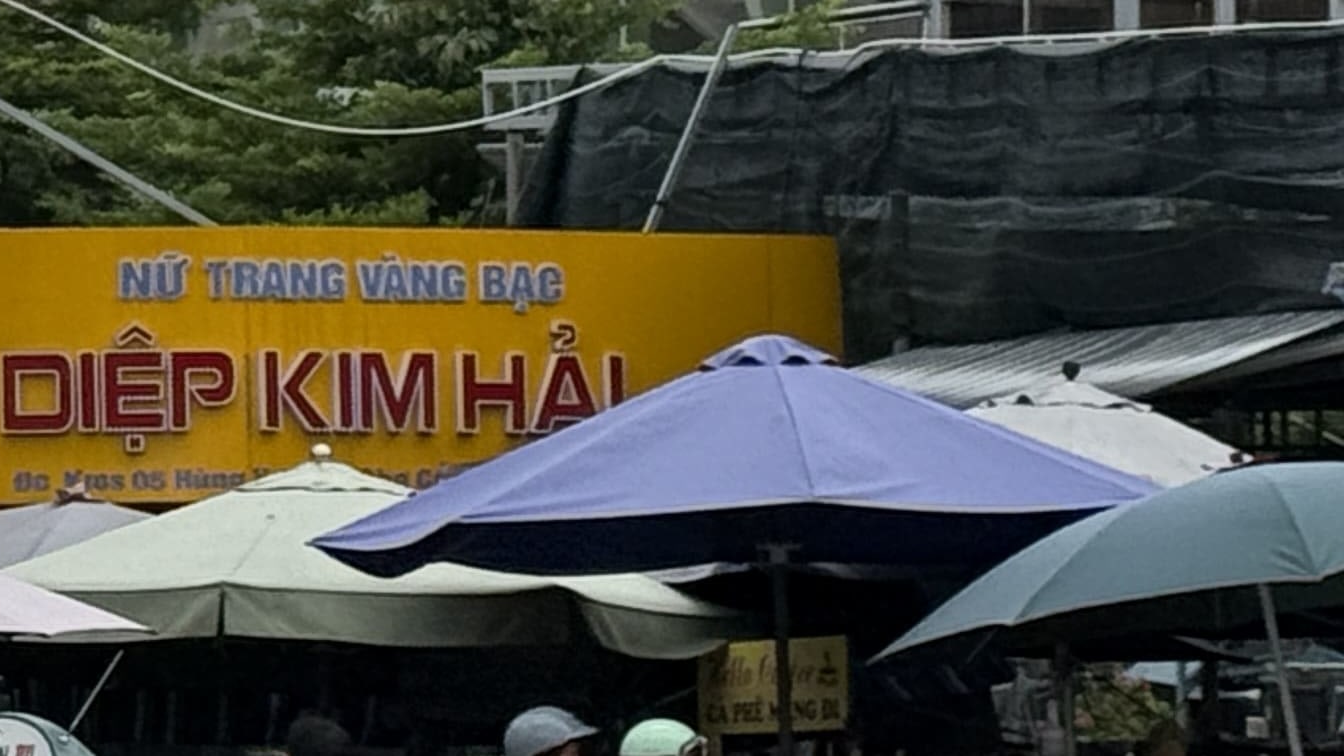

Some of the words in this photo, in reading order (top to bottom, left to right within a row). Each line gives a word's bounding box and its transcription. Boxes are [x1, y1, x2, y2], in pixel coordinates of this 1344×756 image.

[119, 254, 189, 300] NỮ
[206, 258, 347, 301] TRANG
[358, 253, 468, 302] VÀNG
[480, 261, 565, 314] BẠC
[0, 324, 238, 454] DIỆP
[259, 347, 440, 435] KIM
[455, 318, 628, 435] HẢI
